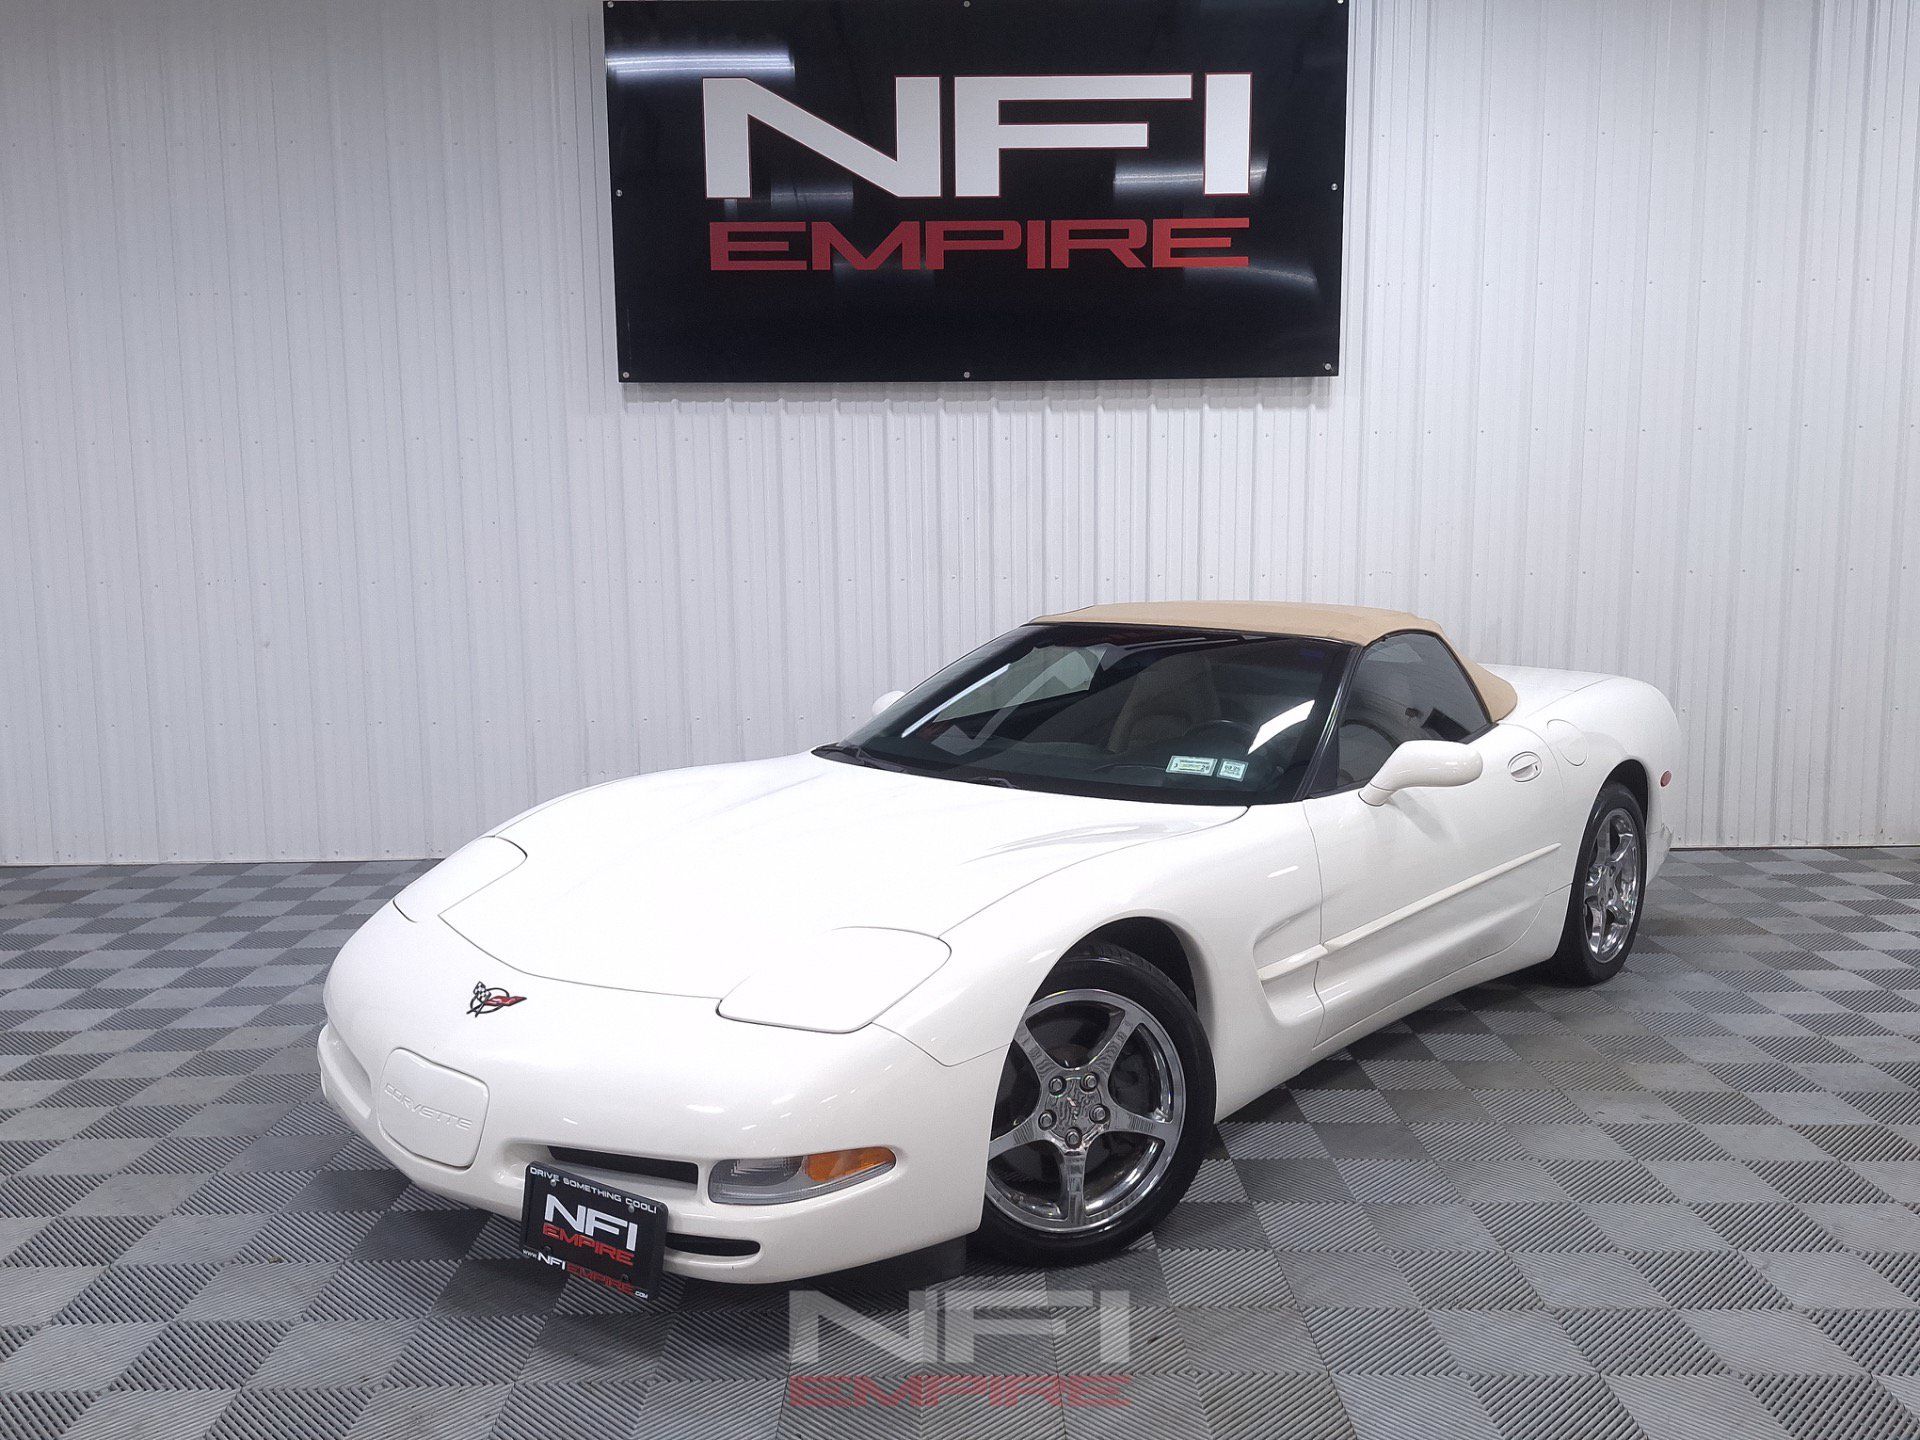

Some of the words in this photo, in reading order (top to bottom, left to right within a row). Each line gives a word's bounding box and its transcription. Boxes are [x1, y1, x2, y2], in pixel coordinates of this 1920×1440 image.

[703, 73, 1253, 199] NFI
[710, 217, 1250, 271] EMPIRE
[384, 1083, 472, 1131] CORVETTE
[530, 1166, 560, 1182] DRIVE
[563, 1177, 622, 1203] SOMETHING
[542, 1222, 635, 1266] EMPIRE
[544, 1193, 638, 1252] NFI
